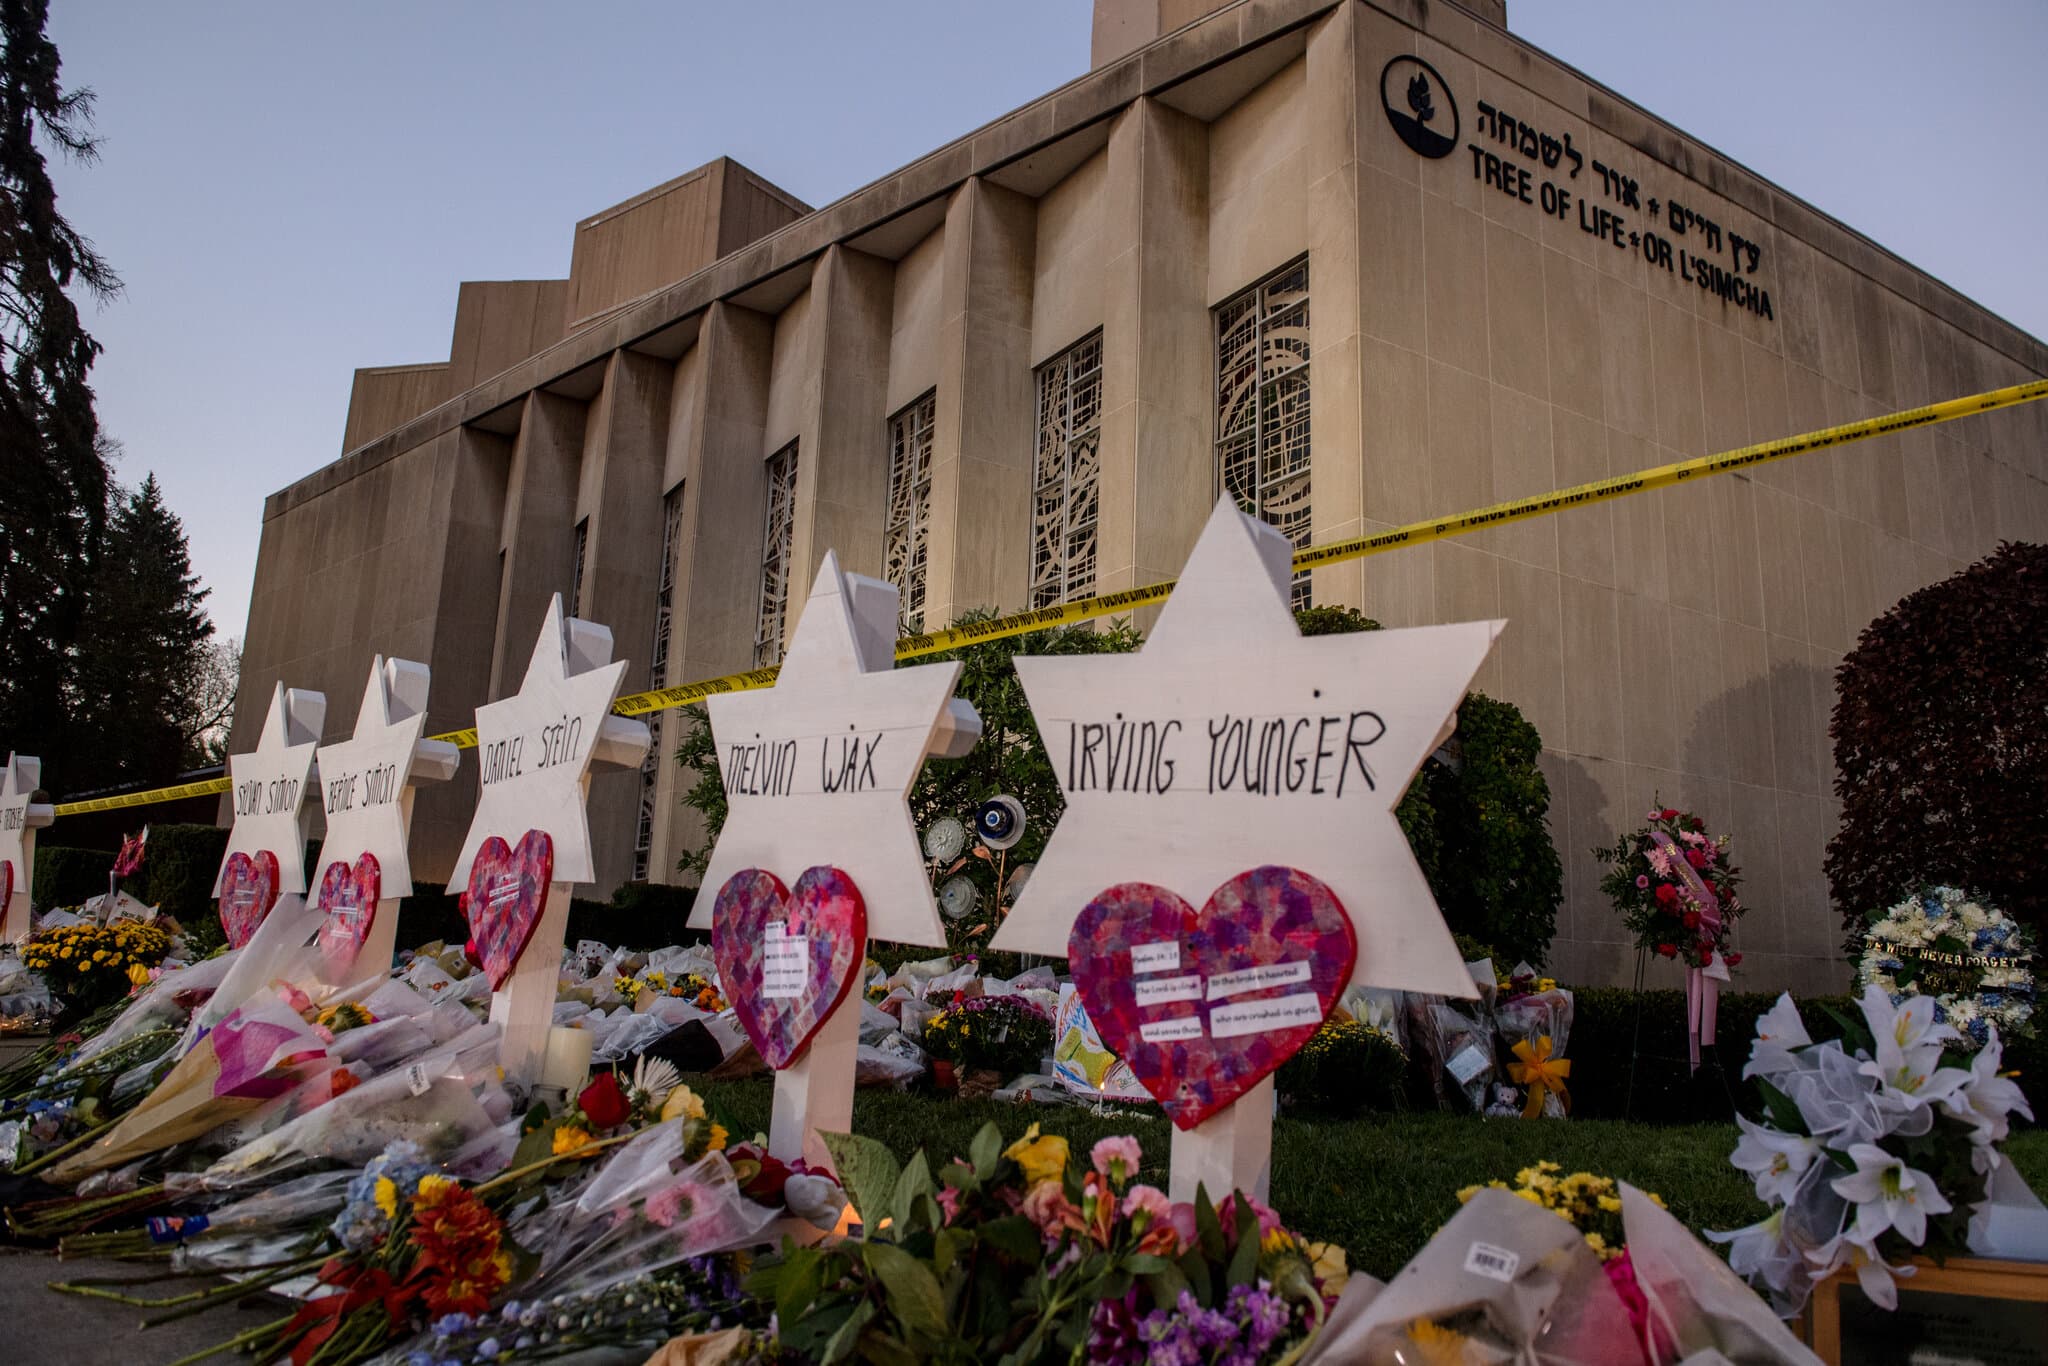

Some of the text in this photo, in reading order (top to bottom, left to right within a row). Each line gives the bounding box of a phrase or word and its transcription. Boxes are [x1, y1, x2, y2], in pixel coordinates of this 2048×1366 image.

[1477, 100, 1761, 273] עץ חיים אור לשמחה
[1468, 144, 1774, 321] TREE OF LIFE OR L'SIMCHA
[483, 714, 582, 786] DANIEL STEIN
[726, 732, 883, 797] MELVIN WAX
[1068, 711, 1386, 798] IRVING YOUNGER
[265, 778, 299, 814] SIMON
[361, 764, 396, 807] SIMON
[1919, 948, 1963, 967] NEVER
[1966, 956, 2018, 969] FORGET
